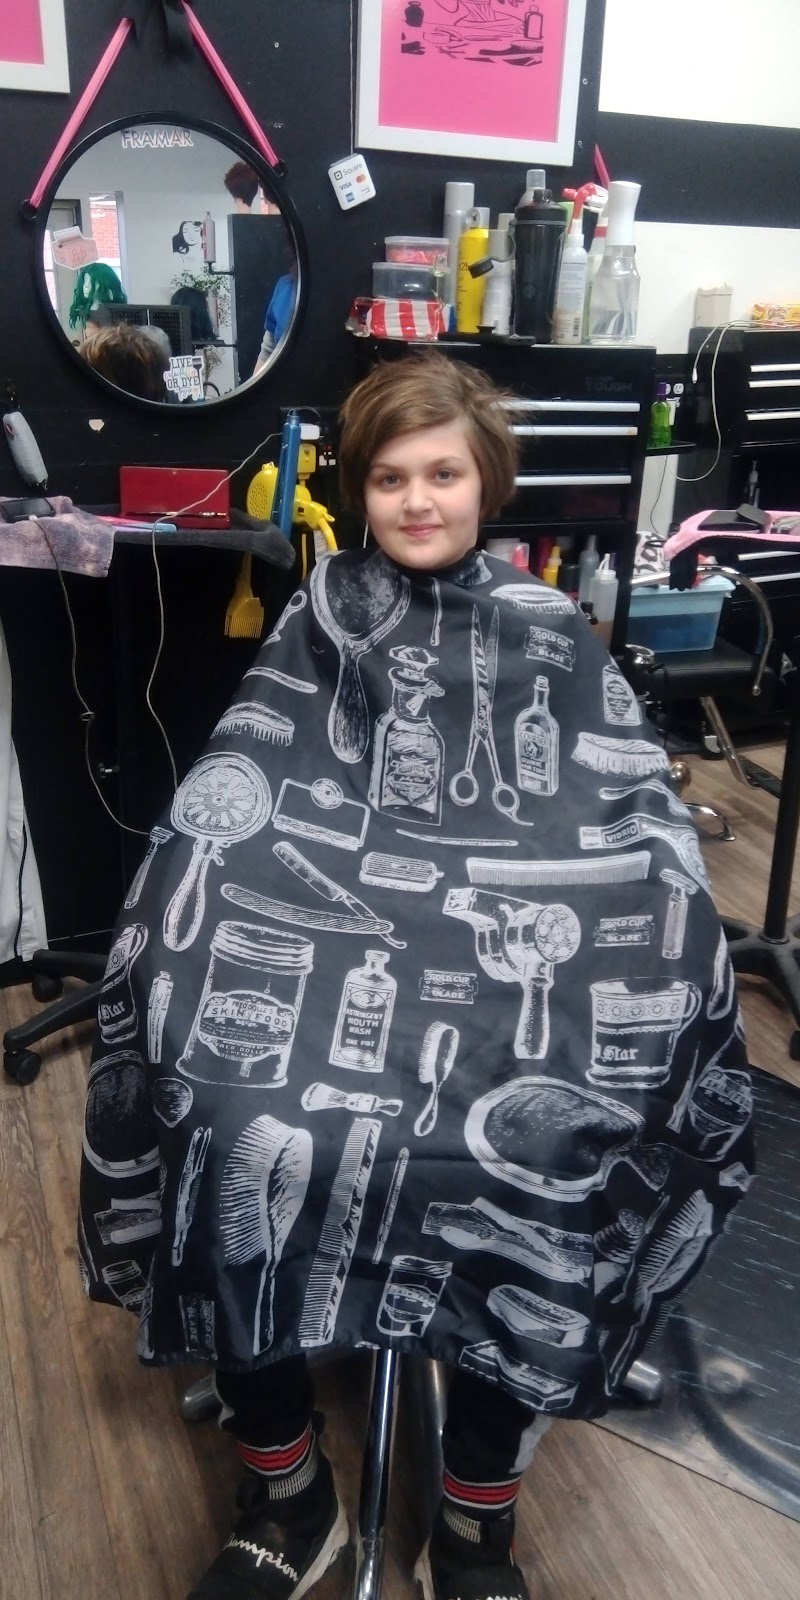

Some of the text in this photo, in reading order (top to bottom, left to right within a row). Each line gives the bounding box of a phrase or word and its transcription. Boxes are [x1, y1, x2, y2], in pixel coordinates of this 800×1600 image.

[121, 129, 194, 149] FRAMAR
[342, 163, 363, 176] Square
[339, 181, 352, 190] VISA
[171, 358, 193, 369] LIVE
[167, 376, 199, 389] OR DYE
[535, 630, 569, 648] GOLD CUP
[538, 649, 564, 663] BLADE
[606, 825, 637, 843] VIDRIO
[628, 919, 646, 927] CUP
[430, 973, 471, 983] GOLD CUP
[431, 989, 466, 999] BLADE
[212, 1007, 287, 1027] SKIN FOOD
[347, 1017, 379, 1028] MOUTH
[348, 1026, 372, 1036] WASH
[345, 1038, 358, 1046] ONE
